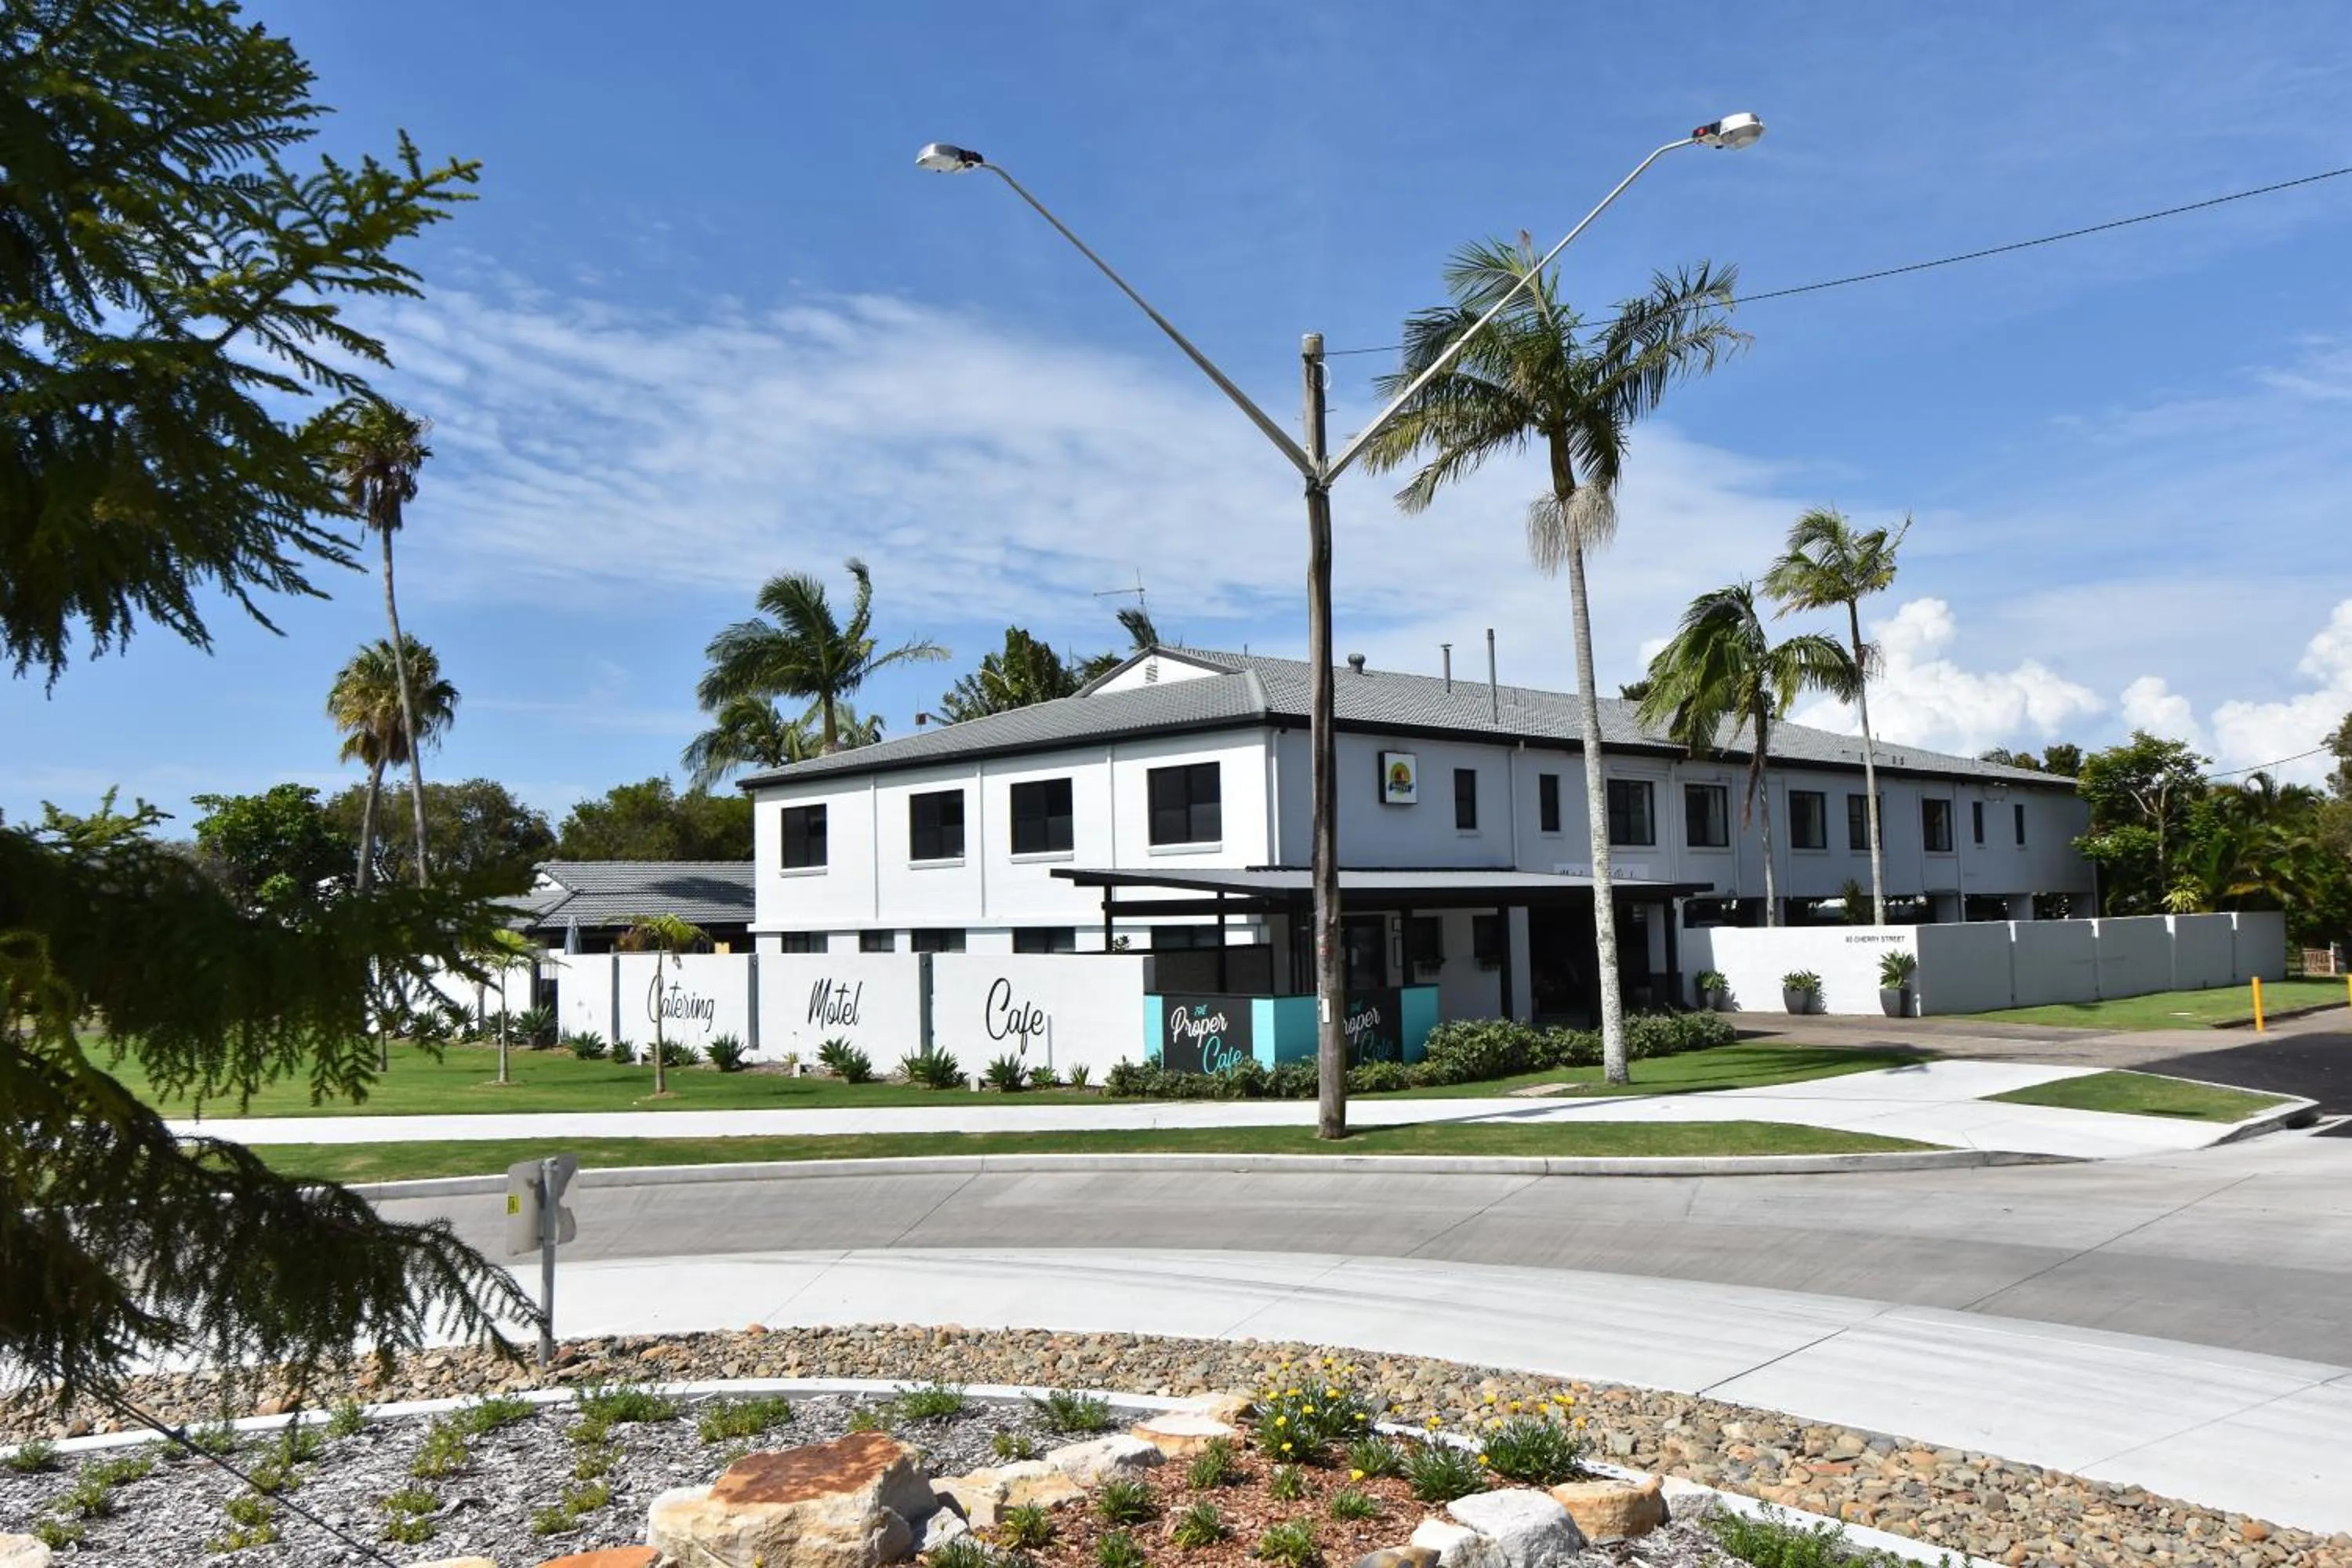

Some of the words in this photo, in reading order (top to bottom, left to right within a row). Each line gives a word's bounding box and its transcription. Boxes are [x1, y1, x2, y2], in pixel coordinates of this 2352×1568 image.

[648, 975, 714, 1033] Catering
[808, 978, 862, 1031] Motel
[986, 978, 1045, 1055] Cafe
[1171, 1007, 1228, 1048] Proper
[1342, 1007, 1381, 1045] roper
[1203, 1036, 1243, 1079] Cafe
